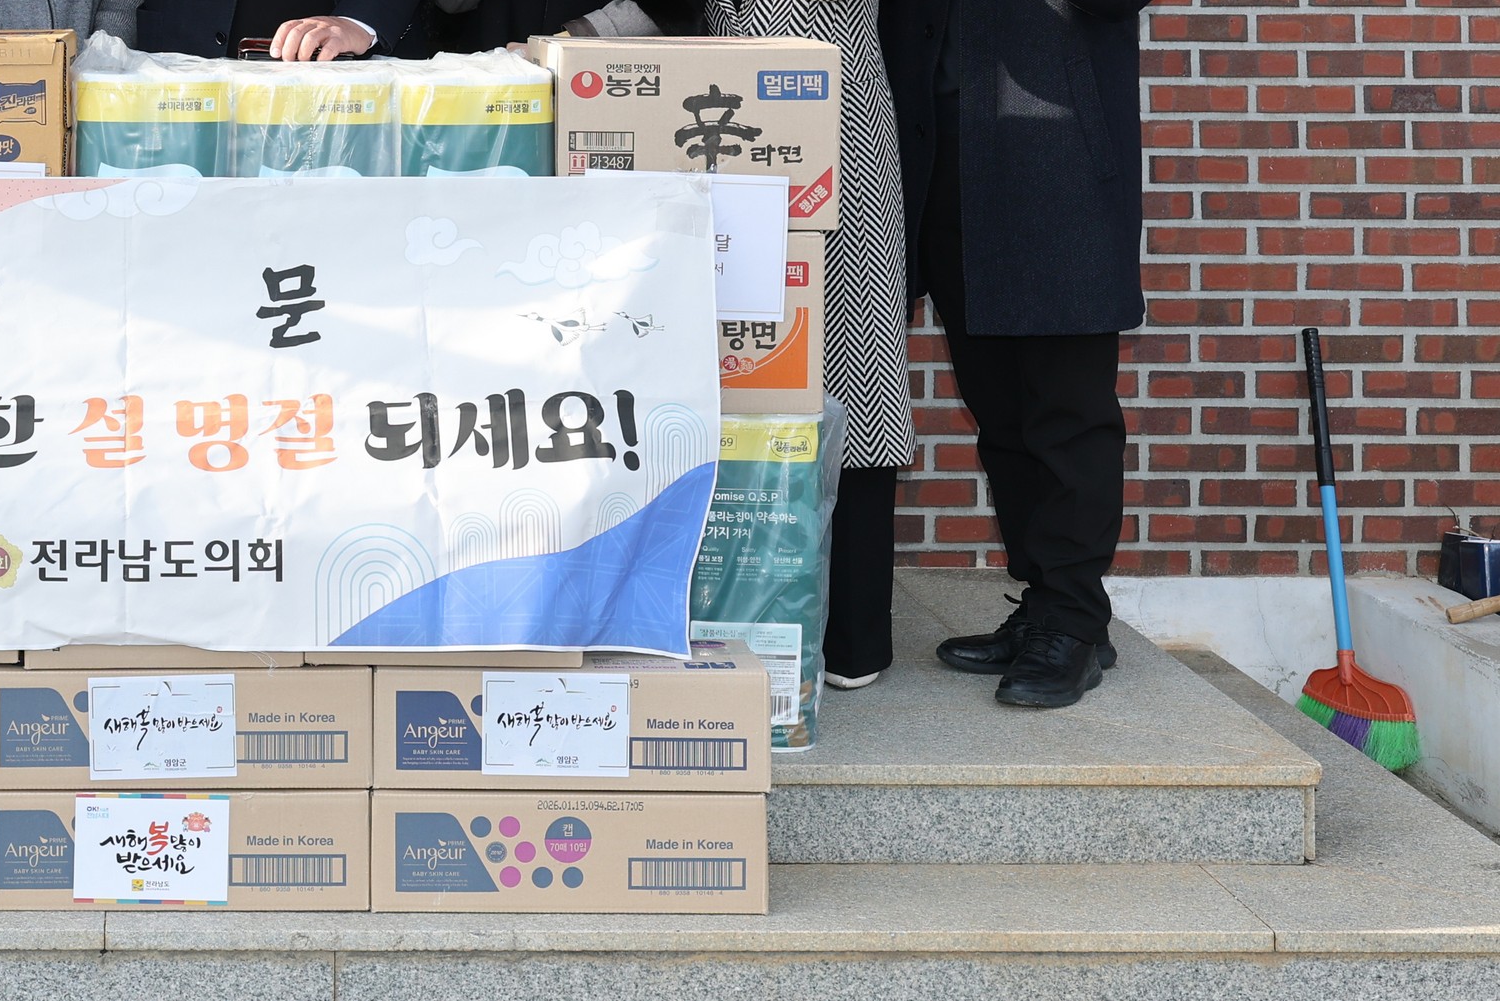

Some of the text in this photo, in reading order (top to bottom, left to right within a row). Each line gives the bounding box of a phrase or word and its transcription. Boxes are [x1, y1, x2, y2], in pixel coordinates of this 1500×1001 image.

[606, 63, 661, 74] 인생을 맛있게
[605, 75, 661, 97] 농심
[763, 73, 824, 97] 멀티팩
[1, 93, 37, 111] 진라면
[591, 156, 632, 169] 가3487
[750, 143, 804, 167] 라면
[797, 183, 829, 215] 행사용
[255, 263, 326, 349] 문
[721, 321, 777, 351] 탕면
[66, 394, 148, 469] 설
[175, 391, 339, 473] 명절
[364, 387, 641, 472] 되세요!
[756, 511, 798, 525] 약속하는
[732, 527, 752, 539] 가치
[29, 537, 285, 583] 전라남도의회
[6, 720, 70, 746] Angeur
[646, 718, 735, 730] Made in Korea
[403, 723, 467, 749] Angeur
[163, 758, 187, 767] 영암군
[556, 755, 579, 765] 영암군
[562, 823, 574, 838] 캡
[4, 842, 68, 867] Angeur
[402, 845, 466, 871] Angeur
[549, 842, 588, 853] 70매 10입
[116, 851, 195, 875] 받으세요
[145, 880, 170, 888] 전라남도
